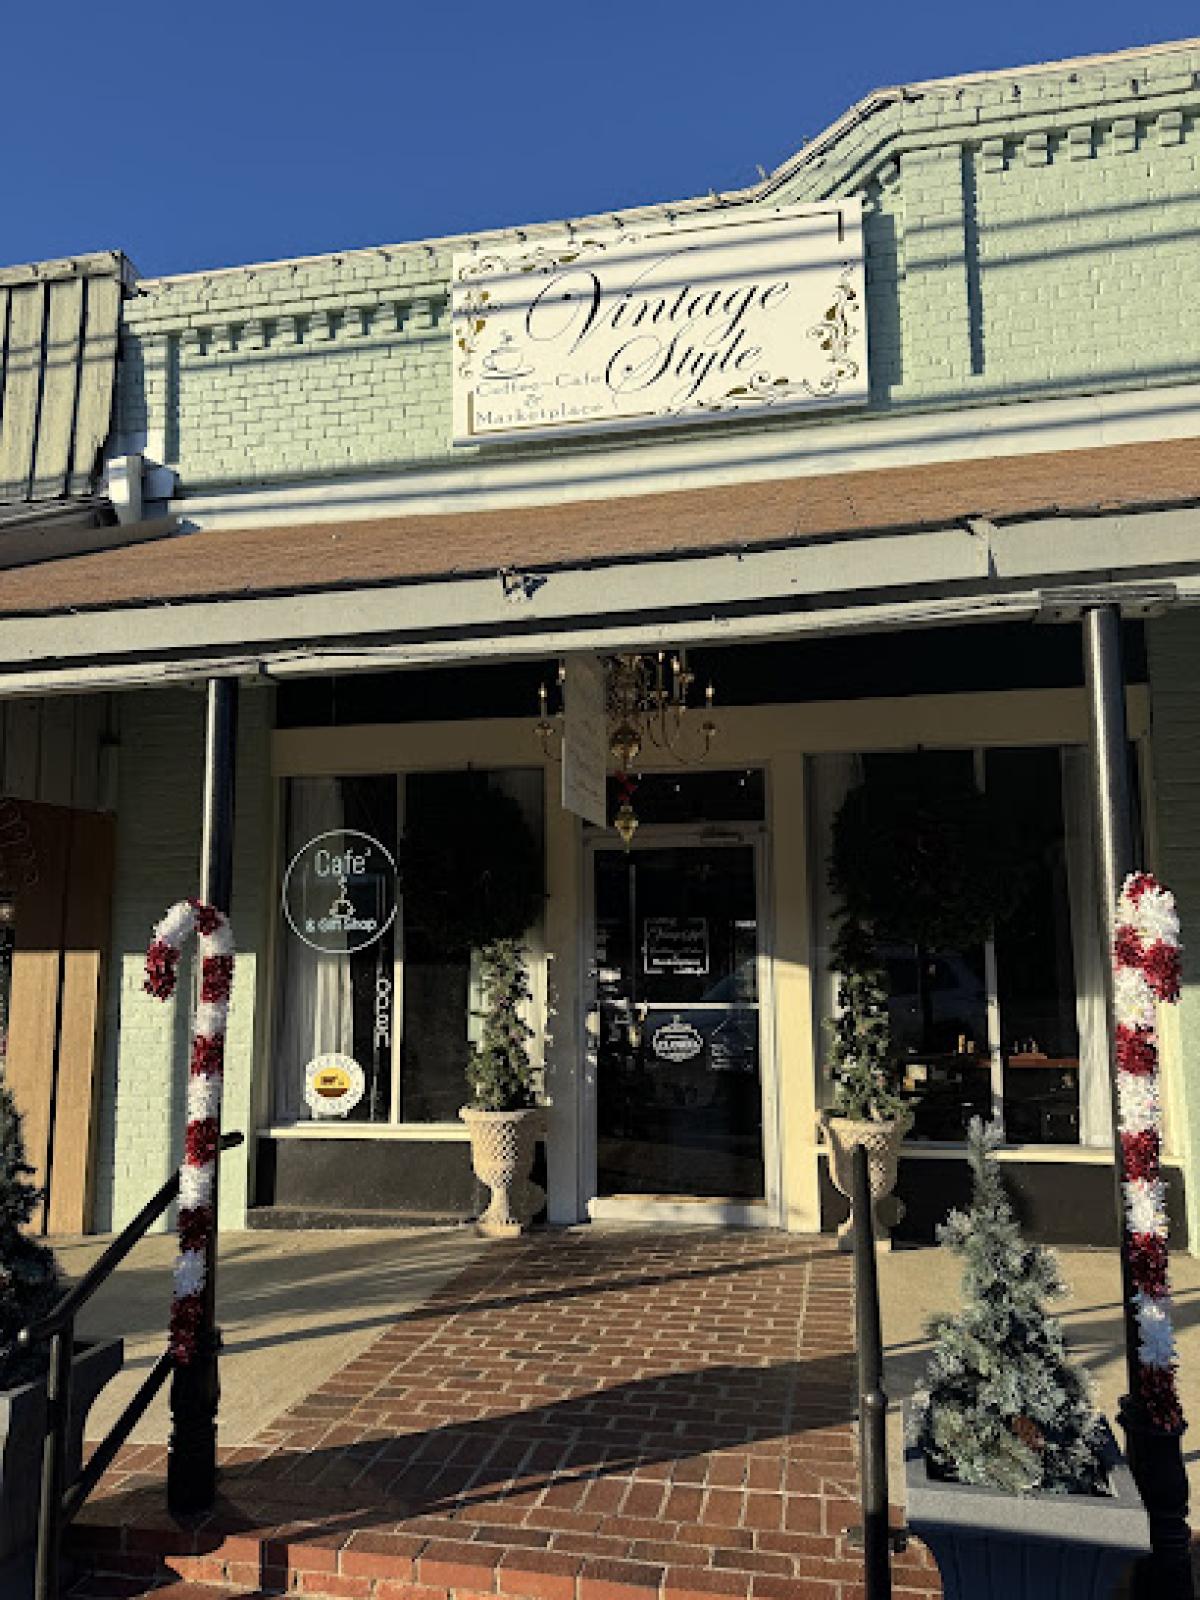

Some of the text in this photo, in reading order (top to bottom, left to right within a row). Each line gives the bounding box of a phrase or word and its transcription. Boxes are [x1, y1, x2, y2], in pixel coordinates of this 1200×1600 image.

[526, 248, 792, 355] Vintage
[606, 320, 764, 406] Style
[475, 402, 604, 427] Marketplace
